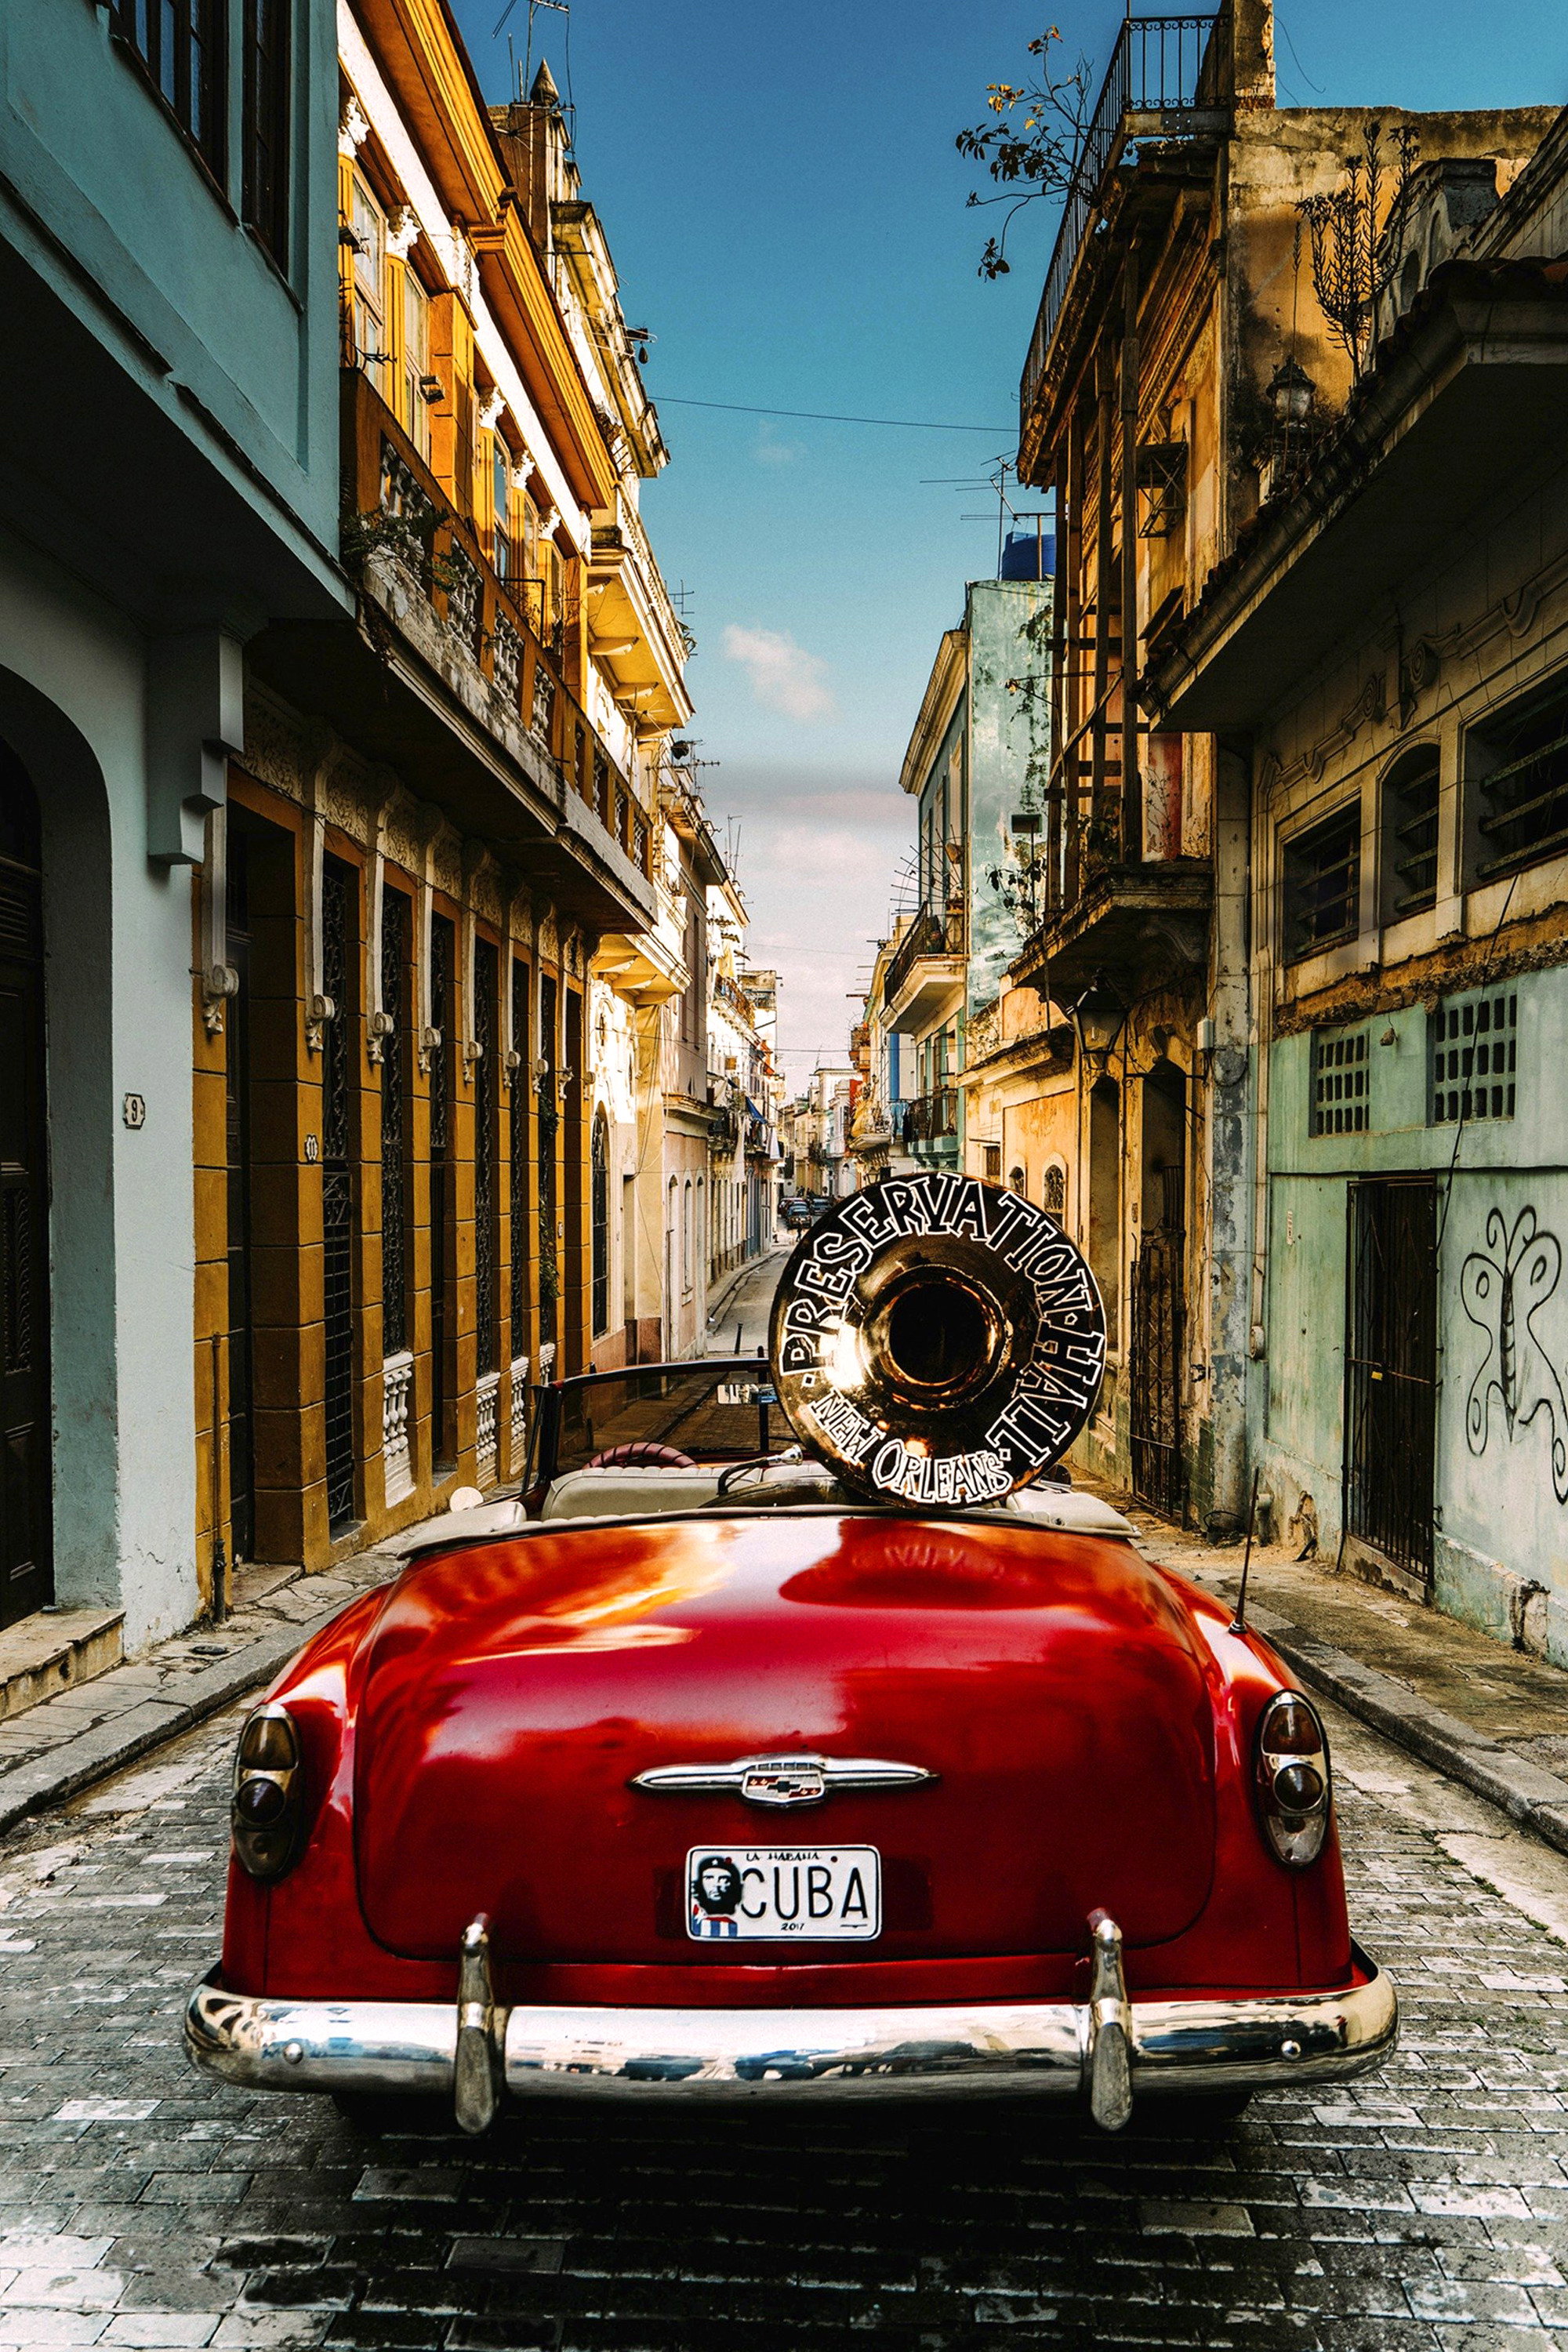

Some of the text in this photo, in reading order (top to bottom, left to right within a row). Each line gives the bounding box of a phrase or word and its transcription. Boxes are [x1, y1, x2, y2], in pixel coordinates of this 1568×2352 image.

[131, 1098, 138, 1122] 9
[779, 1171, 1105, 1467] PRESERVATION HALL
[808, 1386, 1014, 1504] NEW ORLEANS
[746, 1852, 760, 1862] LA
[741, 1866, 869, 1921] CUBA
[780, 1922, 805, 1931] 2017
